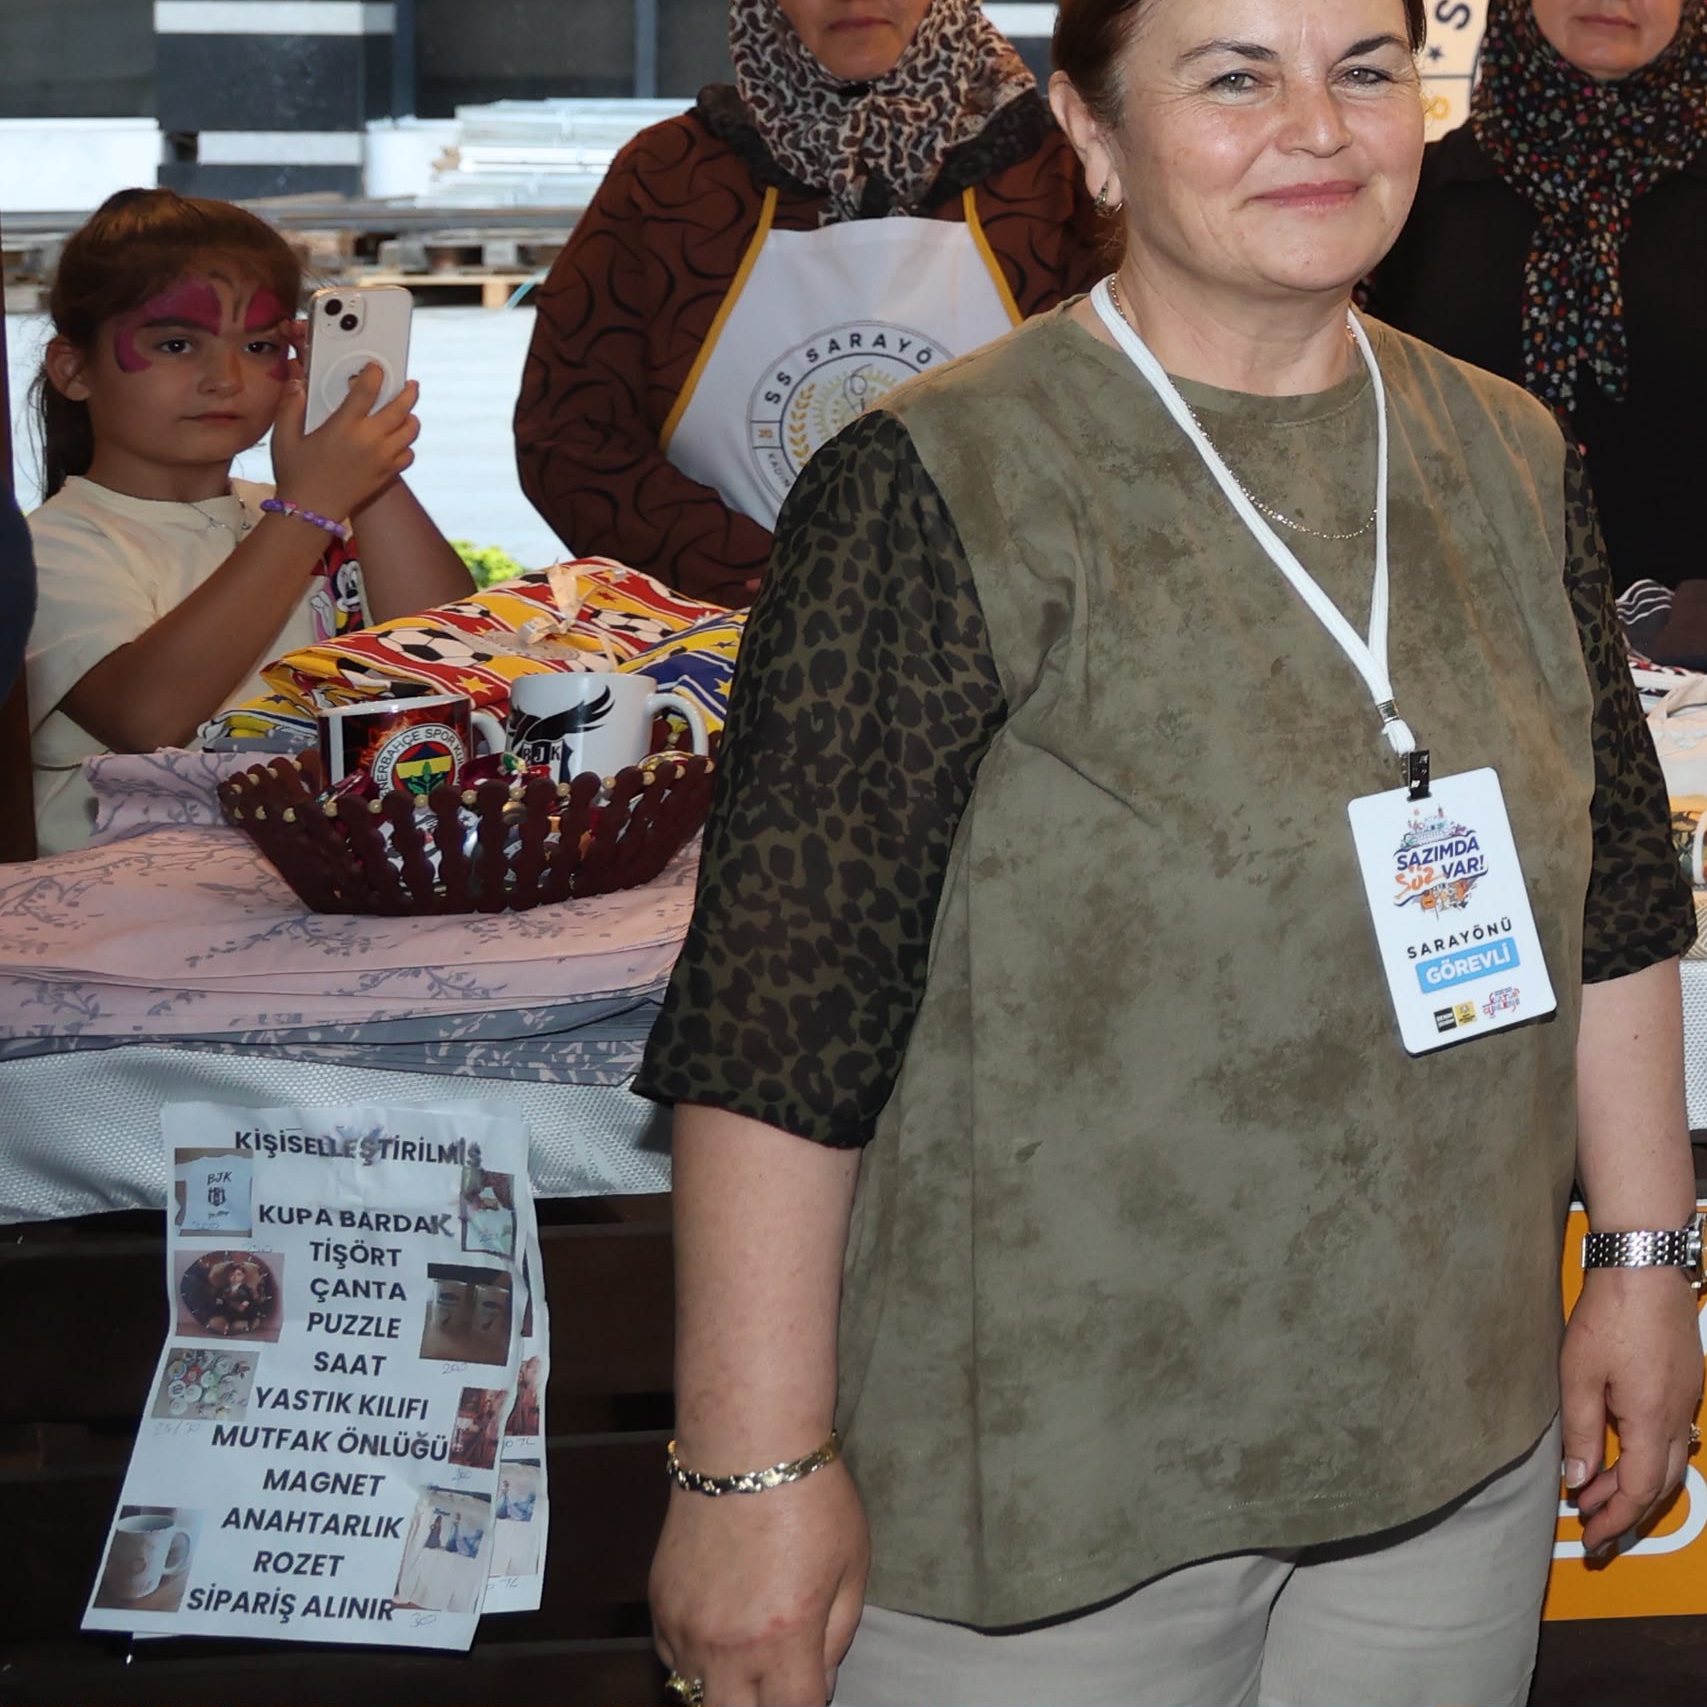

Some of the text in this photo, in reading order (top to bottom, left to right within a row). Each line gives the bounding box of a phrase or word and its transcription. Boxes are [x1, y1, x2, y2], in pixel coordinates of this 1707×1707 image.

[806, 332, 932, 364] SARAYÖ
[425, 728, 454, 747] SPOR
[1396, 836, 1480, 871] SAZIMDA
[1442, 855, 1484, 880] VAR!
[1407, 917, 1512, 959] SARAYÖNÜ
[1426, 943, 1511, 985] GÖREVLİ
[259, 1204, 332, 1227] KUPA
[340, 1210, 454, 1237] BARDAK
[309, 1238, 402, 1269] TİŞÖRT
[310, 1278, 407, 1302] ÇANTA
[307, 1312, 401, 1339] PUZZLE
[314, 1351, 387, 1377] SAAT
[256, 1386, 429, 1421] YASTIK KILIFI
[211, 1424, 328, 1454] MUTFAK
[338, 1426, 449, 1462] ÖNLÜĞÜ
[262, 1468, 386, 1497] MAGNET
[221, 1507, 405, 1539] ANAHTARLIK
[253, 1550, 344, 1577] ROZET
[187, 1582, 396, 1624] SİPARİŞ ALINIR
